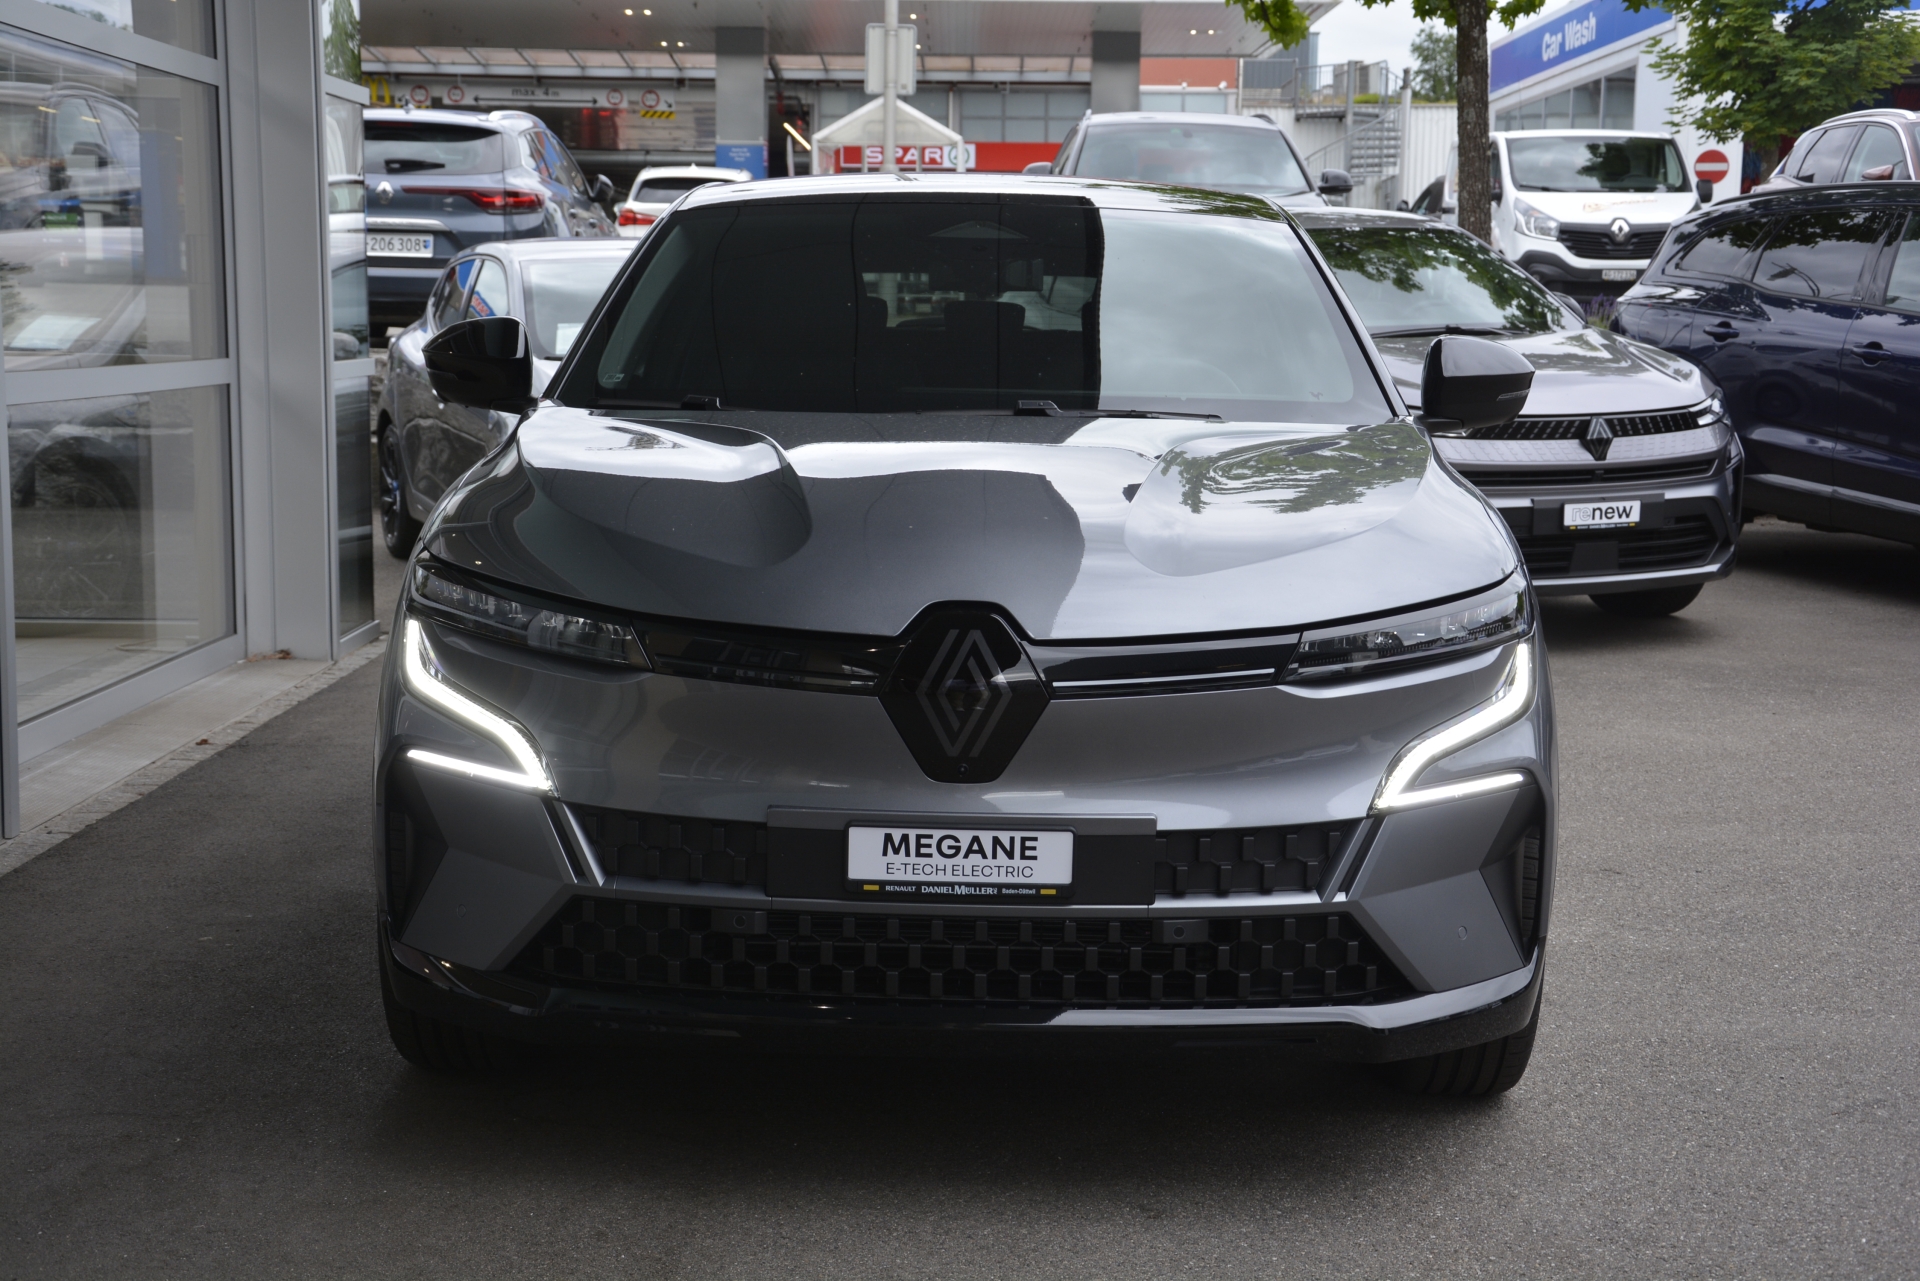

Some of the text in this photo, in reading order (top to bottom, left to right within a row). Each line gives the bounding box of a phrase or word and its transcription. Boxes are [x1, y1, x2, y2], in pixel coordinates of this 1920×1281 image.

[1542, 11, 1596, 62] Car Wash
[1572, 505, 1633, 522] renew
[882, 832, 1039, 861] MEGANE
[886, 862, 1034, 878] E-TECH ELECTRIC
